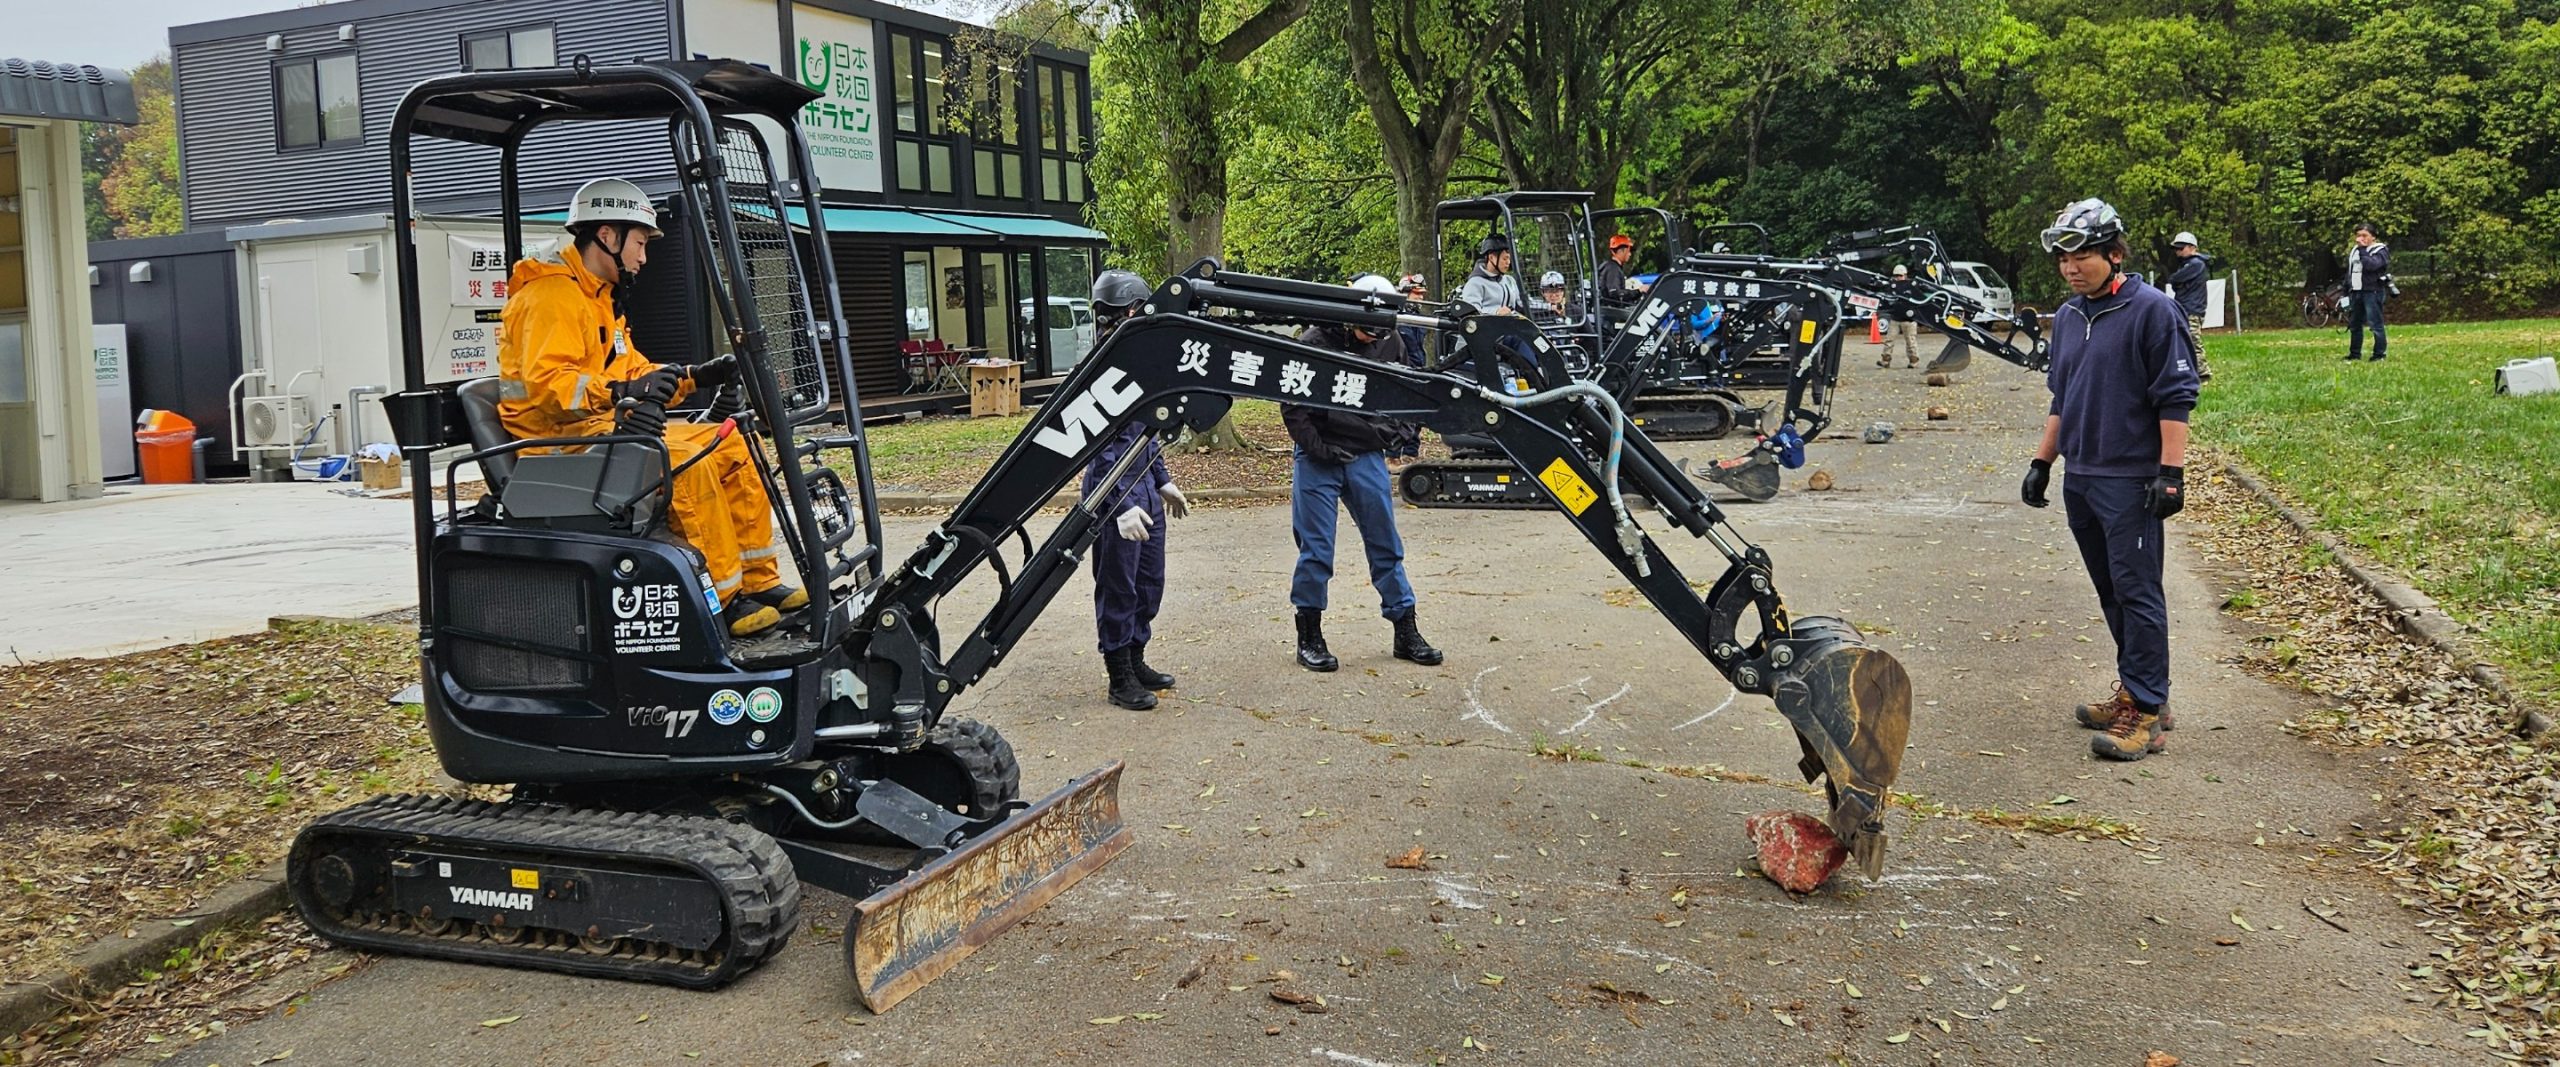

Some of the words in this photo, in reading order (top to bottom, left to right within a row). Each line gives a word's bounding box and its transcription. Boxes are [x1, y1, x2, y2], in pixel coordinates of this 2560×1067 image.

[834, 42, 869, 72] 日本
[836, 73, 870, 102] 財団
[805, 101, 871, 133] ボラセン
[806, 131, 817, 140] THE
[817, 133, 839, 143] NIPPON
[839, 135, 873, 146] FOUNDATION
[848, 148, 874, 161] CENTER
[591, 197, 639, 211] 長岡消防
[1836, 251, 1861, 262] VTC
[1682, 279, 1761, 298] 災害救援
[1627, 297, 1670, 337] VTC
[1176, 338, 1368, 409] 災害救援
[1032, 366, 1145, 459] VTC
[1467, 484, 1506, 492] YANMAR
[644, 584, 679, 600] 日本
[645, 601, 680, 618] 財団
[614, 620, 680, 638] ボラセン
[615, 644, 654, 654] VOLUNTEER
[654, 643, 681, 652] CENTER
[646, 636, 681, 644] FOUNDATION
[449, 885, 534, 911] YANMAR
